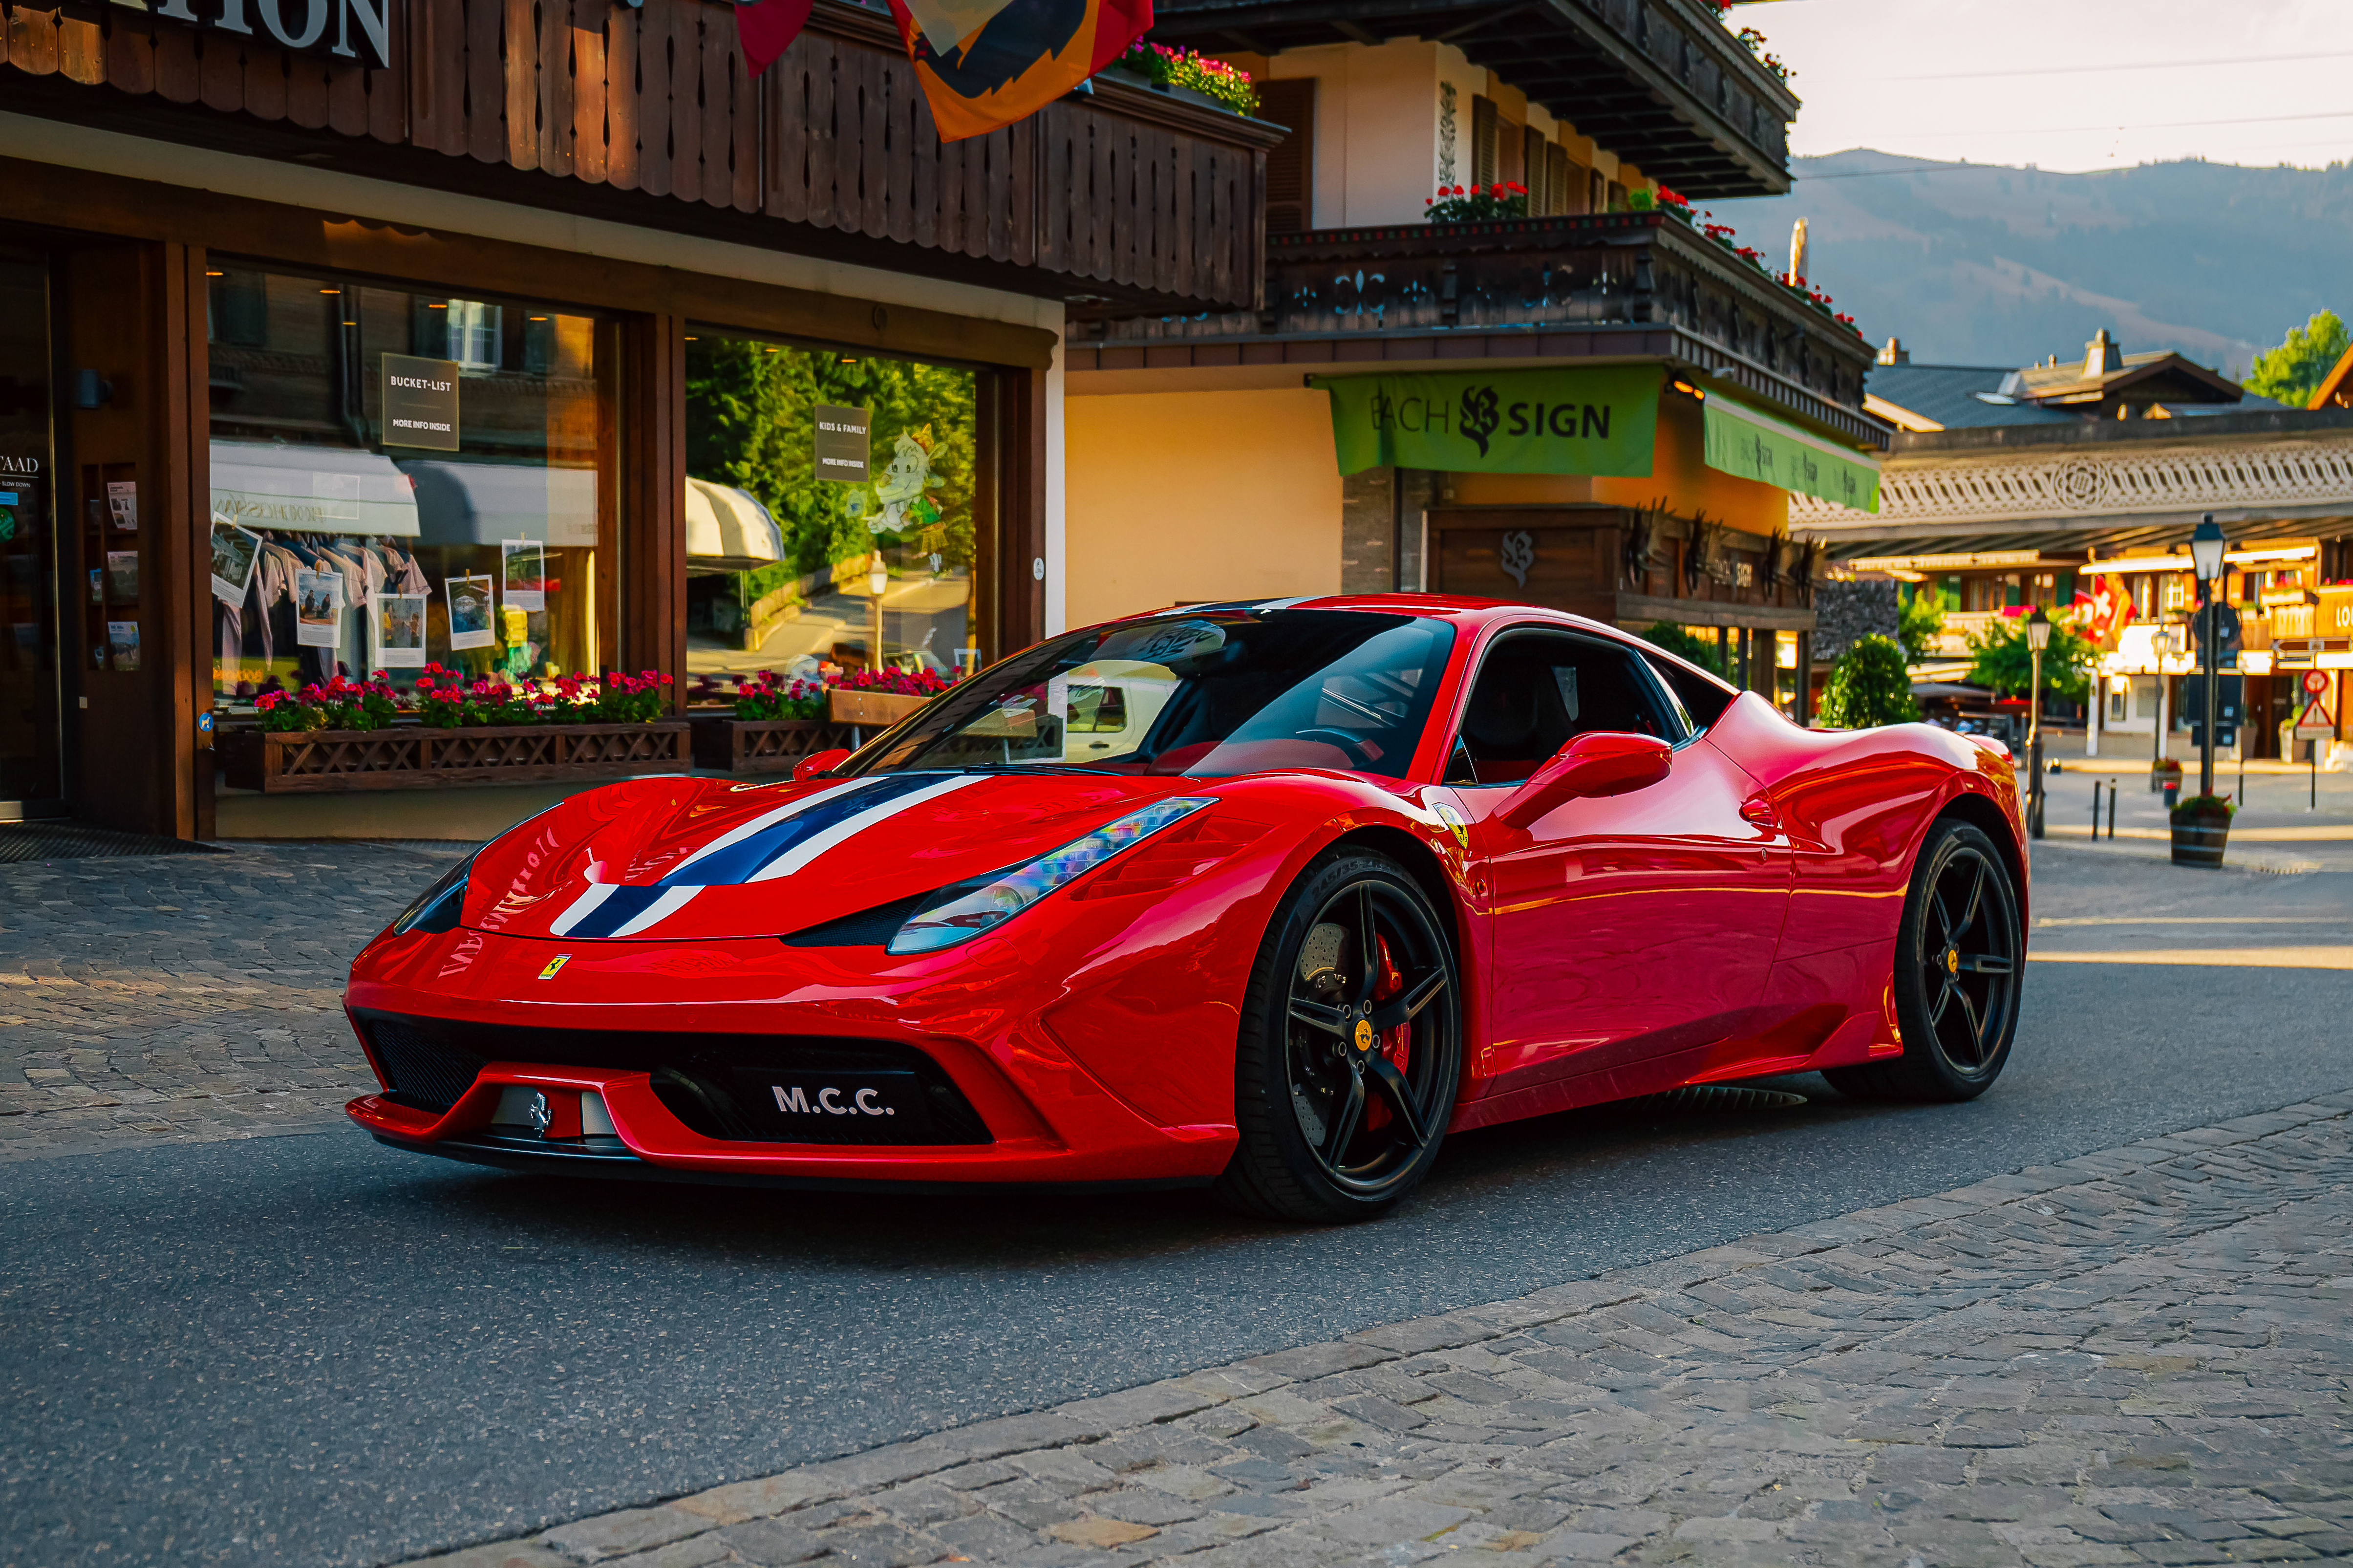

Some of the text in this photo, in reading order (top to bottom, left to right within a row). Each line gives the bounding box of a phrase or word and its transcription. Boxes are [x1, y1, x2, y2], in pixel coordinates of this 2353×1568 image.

[391, 375, 451, 391] BUCKET-LIST
[393, 418, 451, 432] MORE INFO INSIDE
[819, 421, 867, 434] KIDS & FAMILY
[1508, 402, 1611, 440] SIGN
[849, 460, 864, 469] INSIDE
[772, 1086, 895, 1116] M.C.C.
